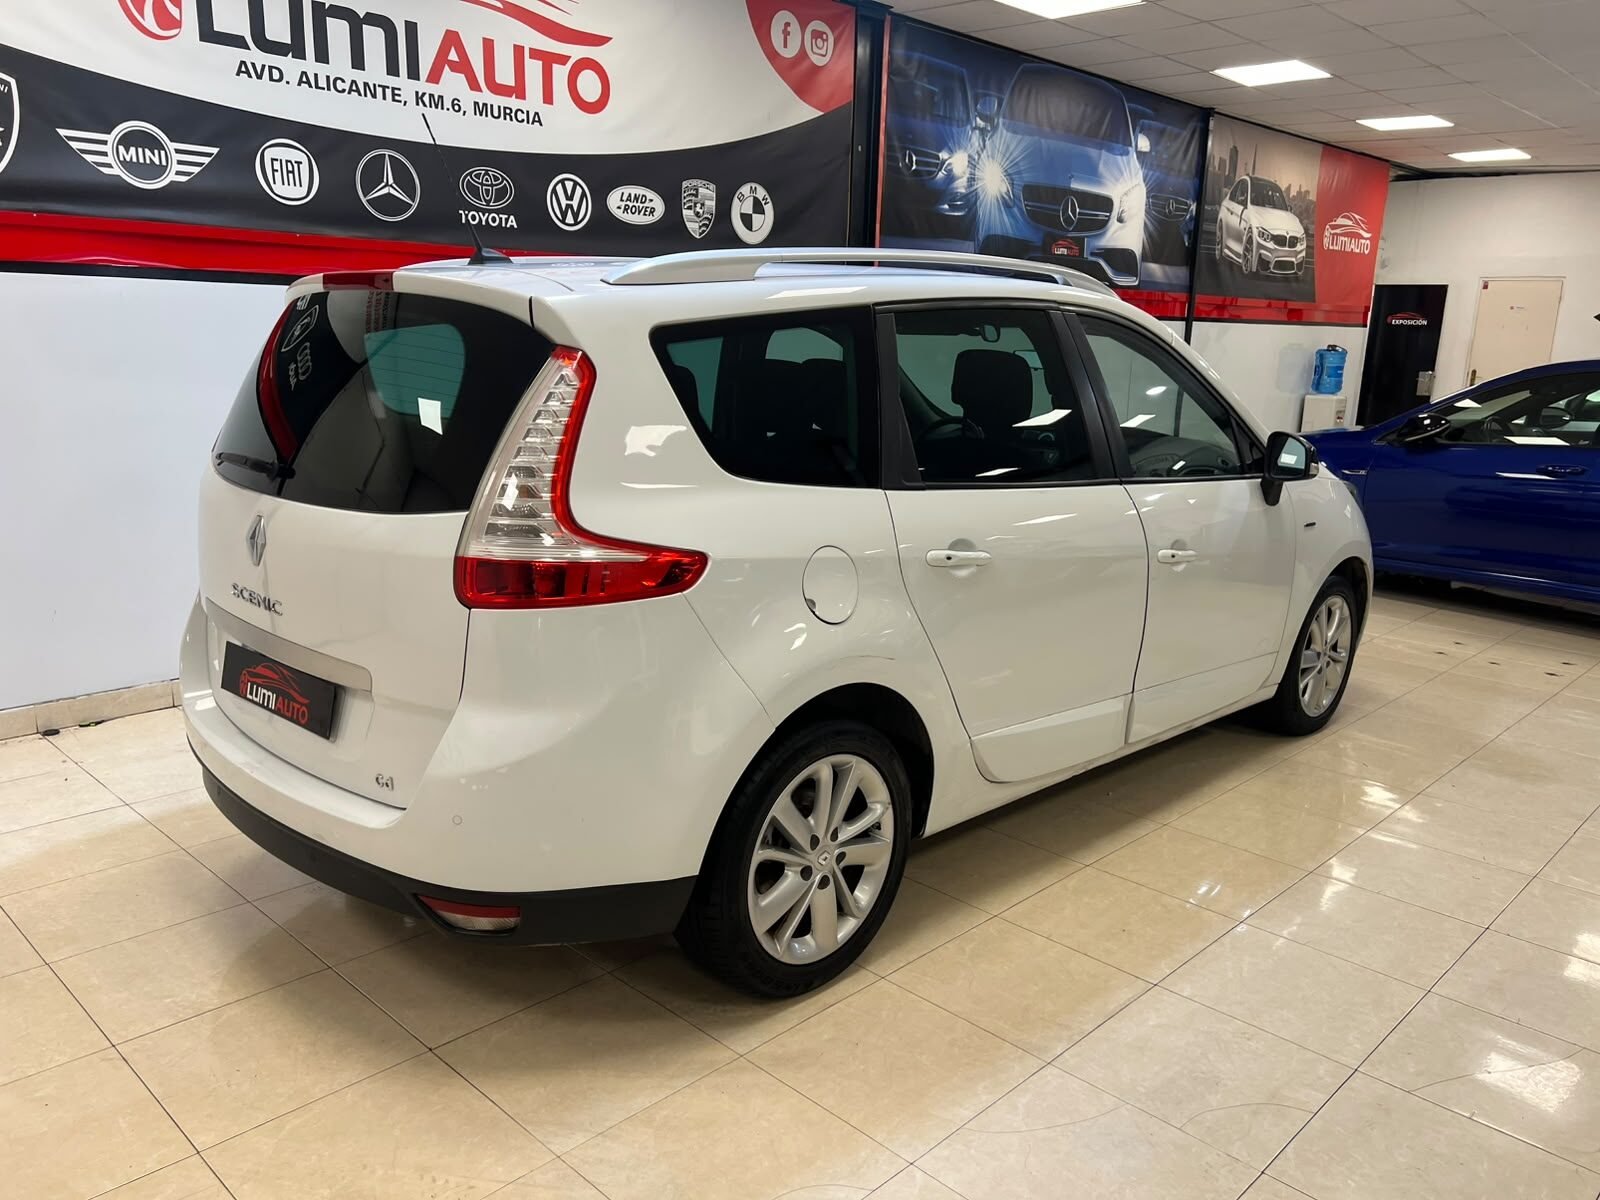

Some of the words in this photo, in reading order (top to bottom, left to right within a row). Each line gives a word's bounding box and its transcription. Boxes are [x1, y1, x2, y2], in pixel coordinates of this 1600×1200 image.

[235, 60, 290, 85] AVD.
[297, 70, 407, 107] ALICANTE,
[414, 90, 467, 117] KM.6,
[473, 100, 543, 127] MURCIA
[118, 144, 168, 167] MINI
[270, 157, 303, 188] FIAT
[620, 191, 648, 204] LAND
[459, 209, 518, 229] TOYOTA
[622, 203, 656, 217] ROVER
[231, 582, 283, 616] SCENIC
